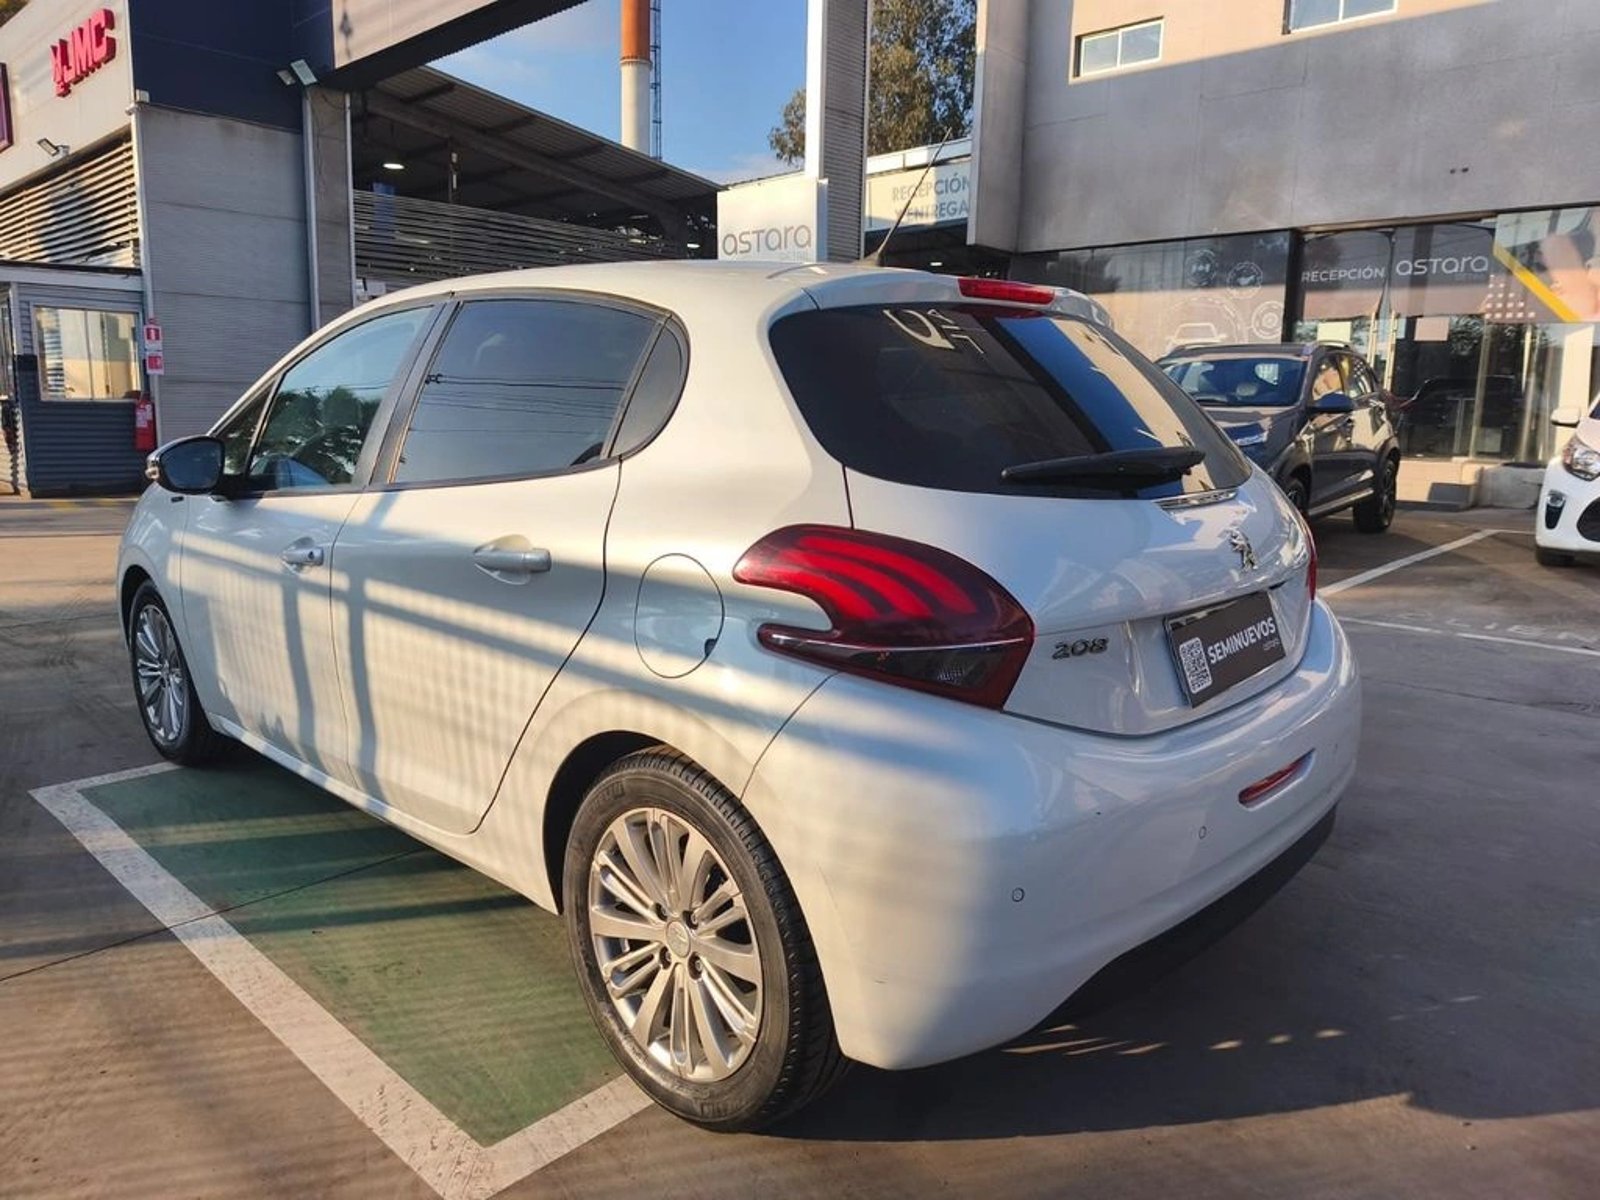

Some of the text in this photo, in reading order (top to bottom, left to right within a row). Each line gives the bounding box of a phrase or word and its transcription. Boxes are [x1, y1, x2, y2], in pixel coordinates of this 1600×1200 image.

[1301, 266, 1386, 283] RECEPCIÓN
[1052, 638, 1109, 660] 208
[1207, 616, 1276, 664] SEMINUEVOS
